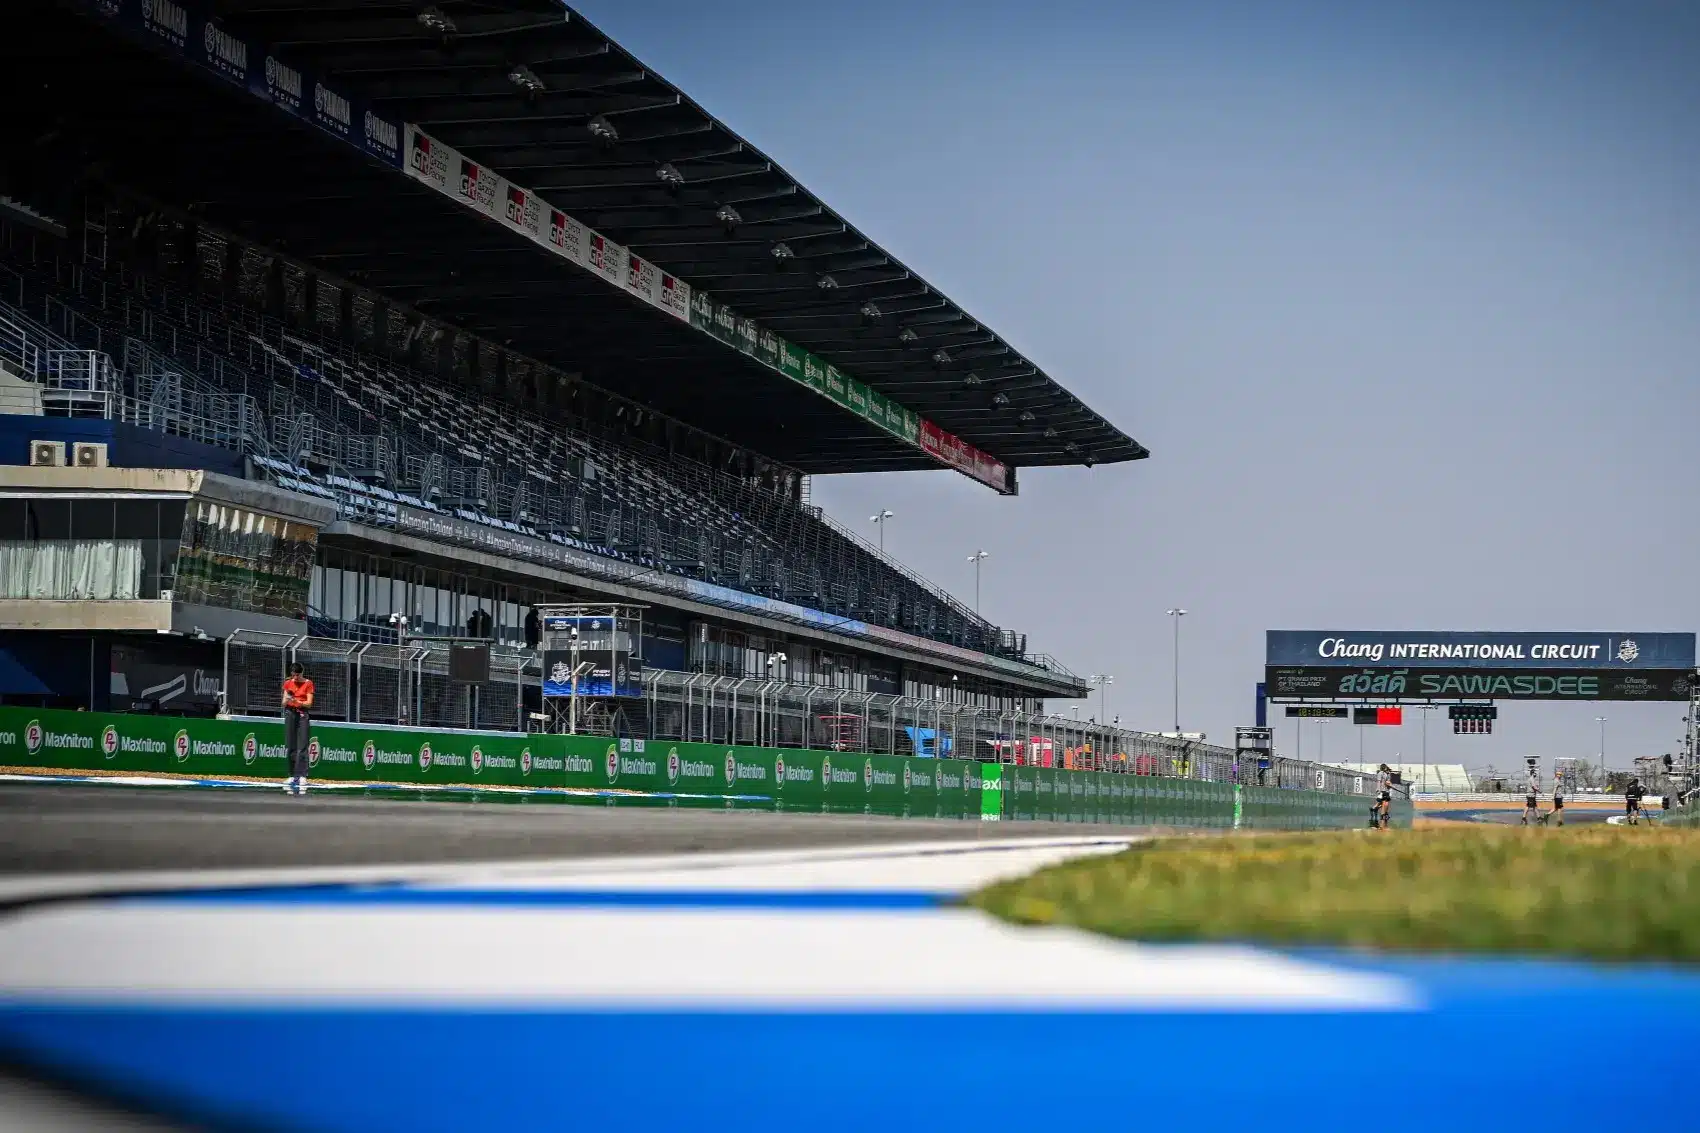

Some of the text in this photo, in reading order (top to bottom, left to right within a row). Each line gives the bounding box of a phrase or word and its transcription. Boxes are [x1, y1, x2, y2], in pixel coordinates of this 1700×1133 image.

[144, 19, 185, 48] RACING
[208, 54, 245, 79] RACING
[268, 86, 300, 107] RACING
[317, 112, 349, 134] RACING
[367, 139, 396, 158] RACING
[430, 144, 449, 161] TOYOTA
[411, 147, 430, 175] GR
[428, 166, 446, 186] Racing
[478, 170, 497, 186] TOYOTA
[460, 175, 477, 200] GR
[477, 193, 494, 211] Racing
[506, 200, 523, 225] GR
[523, 219, 539, 235] Racing
[550, 224, 564, 247] GR
[1318, 638, 1601, 661] Chang INTERNATIONAL CIRCUIT
[193, 668, 220, 702] Chang
[1339, 668, 1409, 694] สวัสดี
[1420, 674, 1599, 695] SAWASDEE
[1625, 677, 1648, 685] Chang
[44, 732, 94, 750] Maxnitron
[121, 736, 168, 753] Maxnitron
[192, 740, 236, 756] Maxnitron
[259, 744, 289, 759] Maxnitr
[323, 746, 358, 762] Maxnitron
[377, 750, 413, 764] Maxnitron
[433, 752, 466, 767] Maxnitron
[484, 755, 516, 768] Maxnitron
[533, 757, 562, 769] Maxnitron
[620, 757, 657, 775] Maxnitron
[681, 760, 714, 777] Maxnitron
